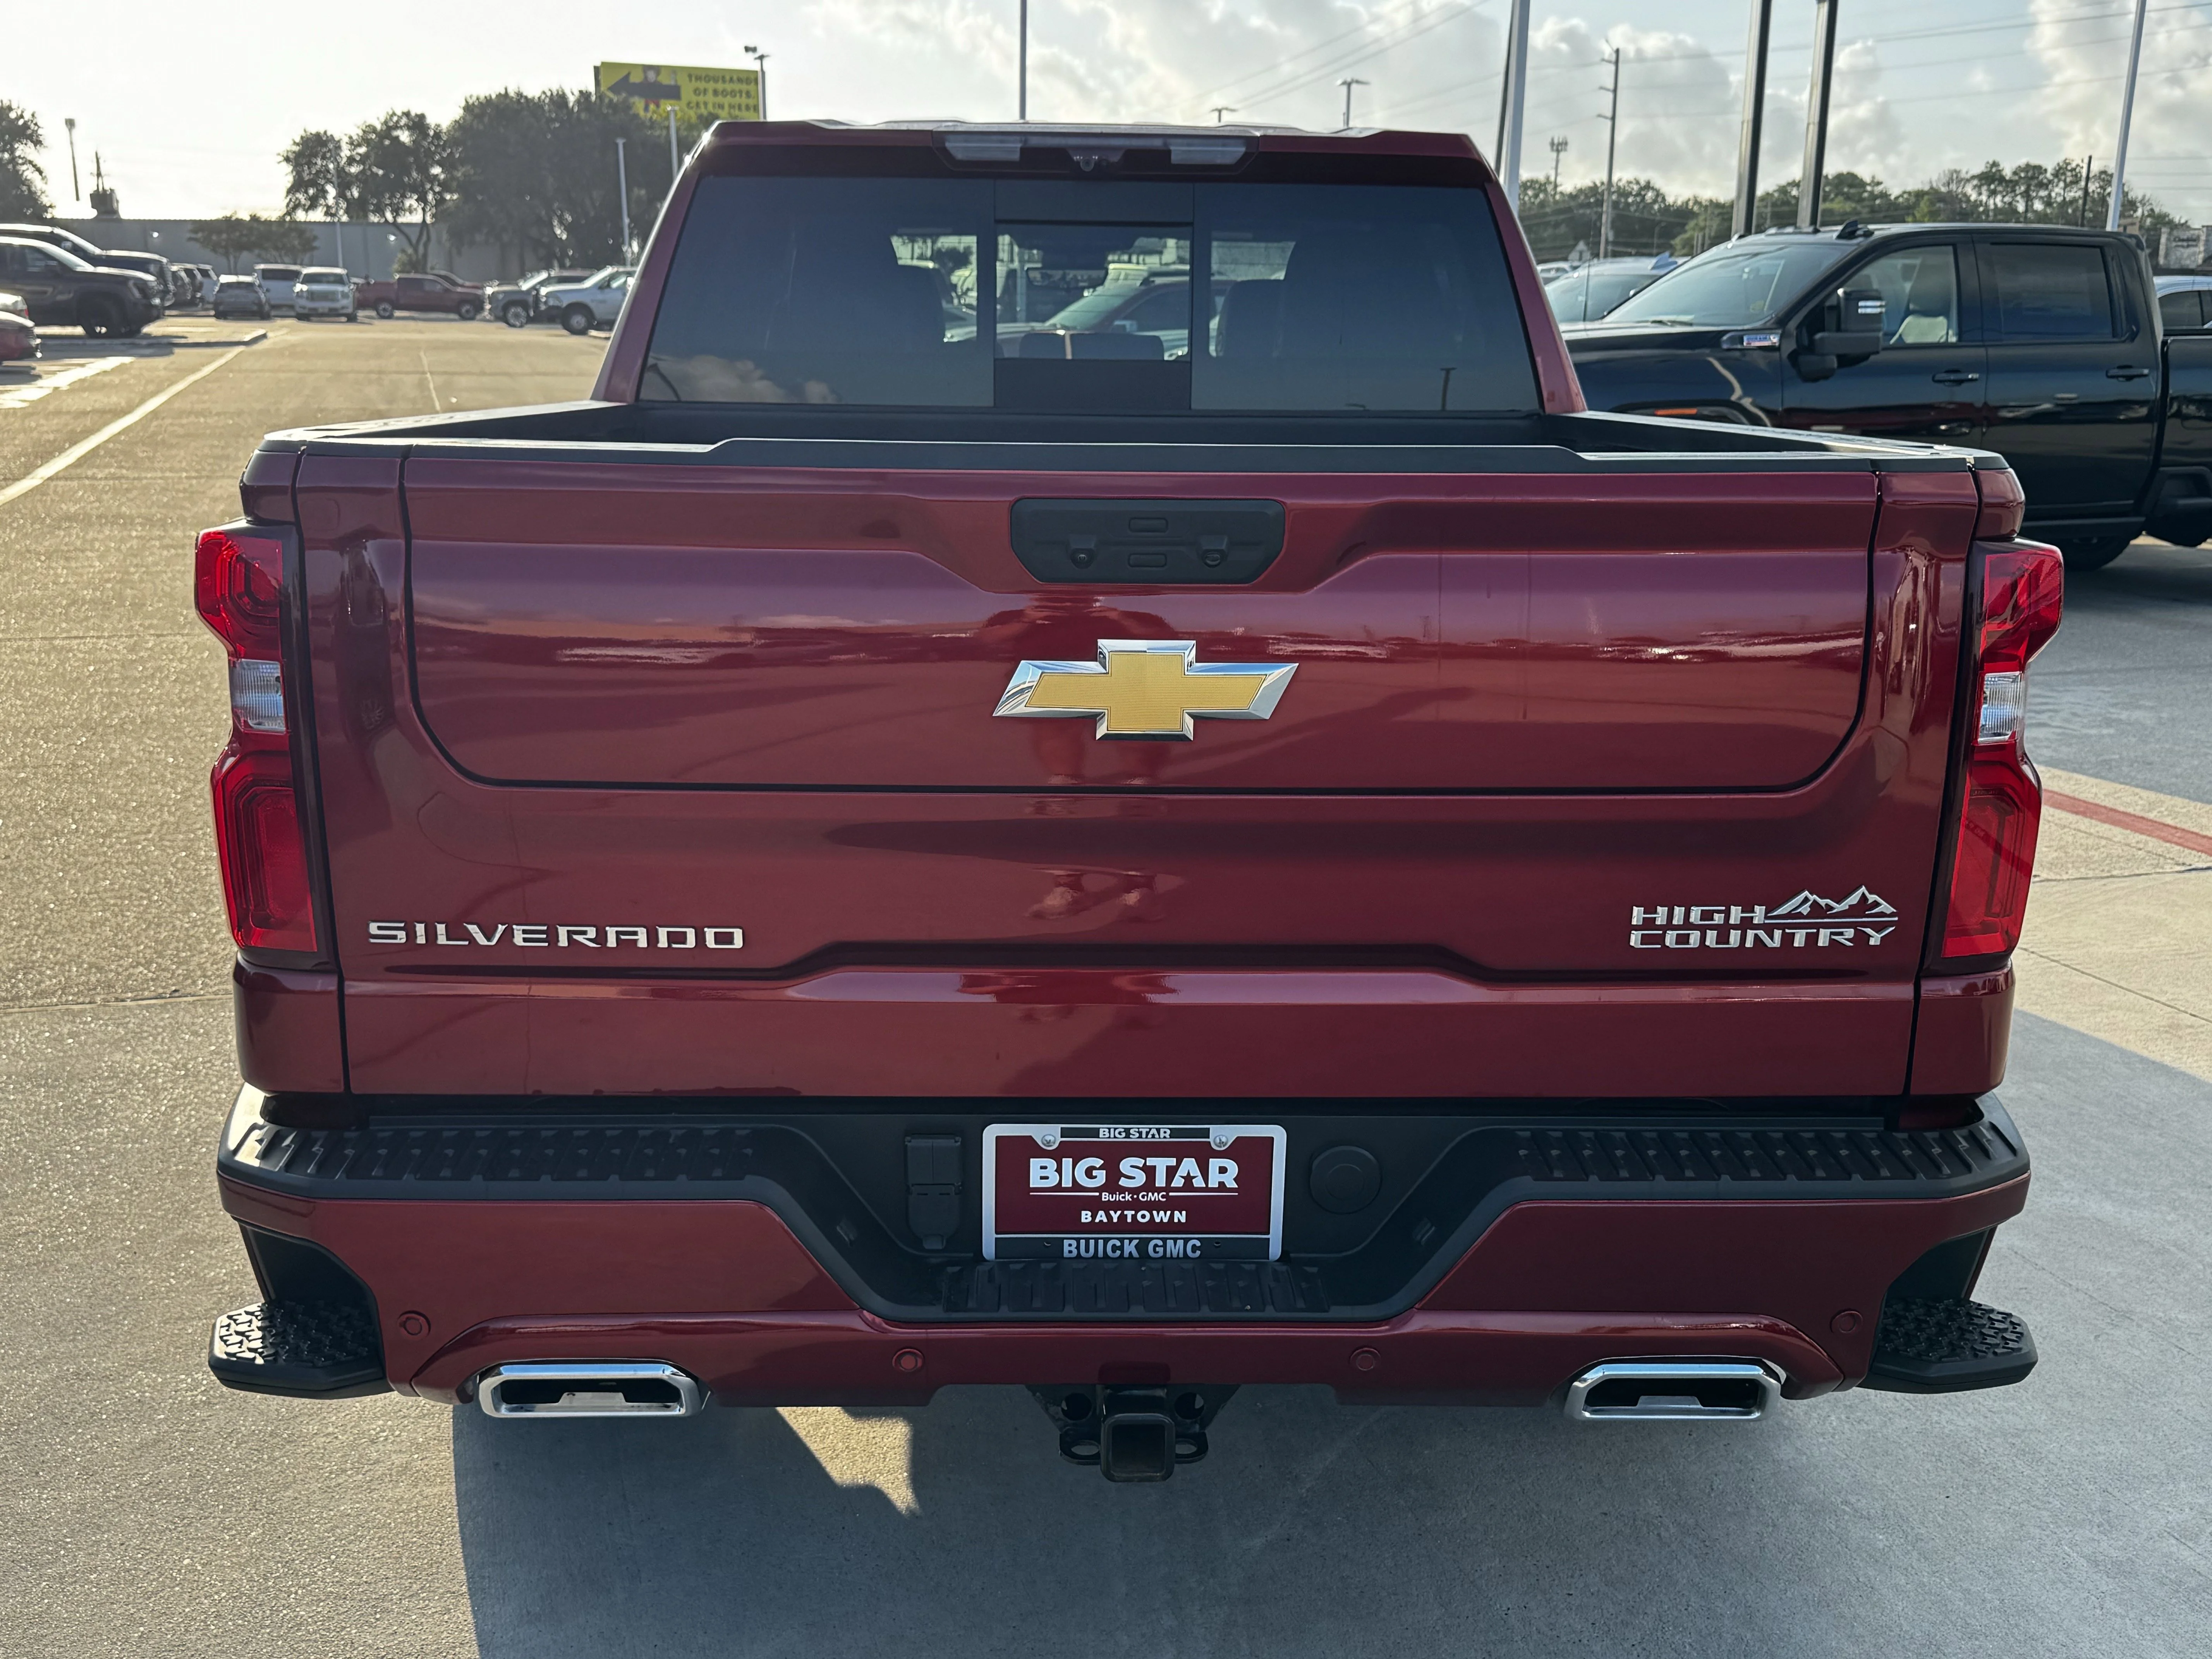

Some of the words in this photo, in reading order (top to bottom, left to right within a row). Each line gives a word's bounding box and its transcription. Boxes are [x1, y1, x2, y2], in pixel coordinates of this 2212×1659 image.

[693, 87, 708, 97] OF
[686, 100, 709, 110] GET
[712, 101, 725, 111] IN
[1631, 905, 1766, 925] HIGH
[369, 922, 744, 949] SILVERADO
[1630, 926, 1896, 948] COUNTRY
[1099, 1128, 1126, 1139] BIG
[1129, 1128, 1171, 1139] STAR
[1029, 1157, 1106, 1188] BIG
[1118, 1157, 1239, 1188] STAR
[1081, 1210, 1187, 1223] BAYTOWN
[1063, 1239, 1140, 1258] BUICK
[1147, 1239, 1201, 1258] GMC
